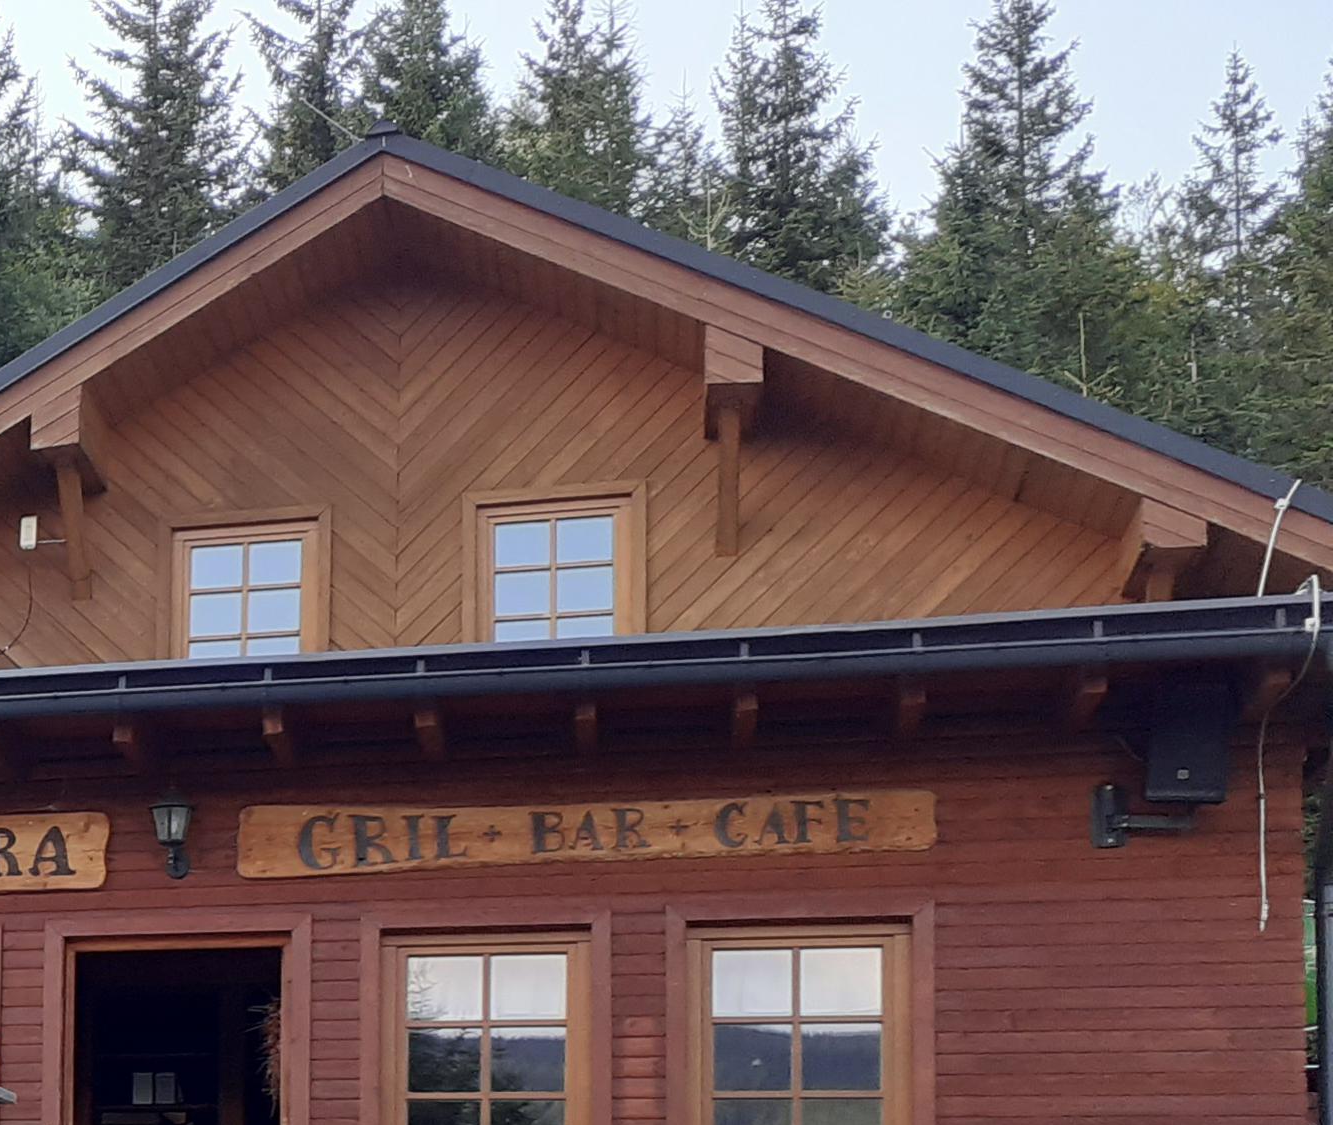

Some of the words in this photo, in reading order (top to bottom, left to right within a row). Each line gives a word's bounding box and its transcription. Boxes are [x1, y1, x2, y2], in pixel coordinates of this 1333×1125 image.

[297, 811, 468, 871] GRIL
[529, 807, 651, 854] BAR
[712, 798, 871, 849] CAFE
